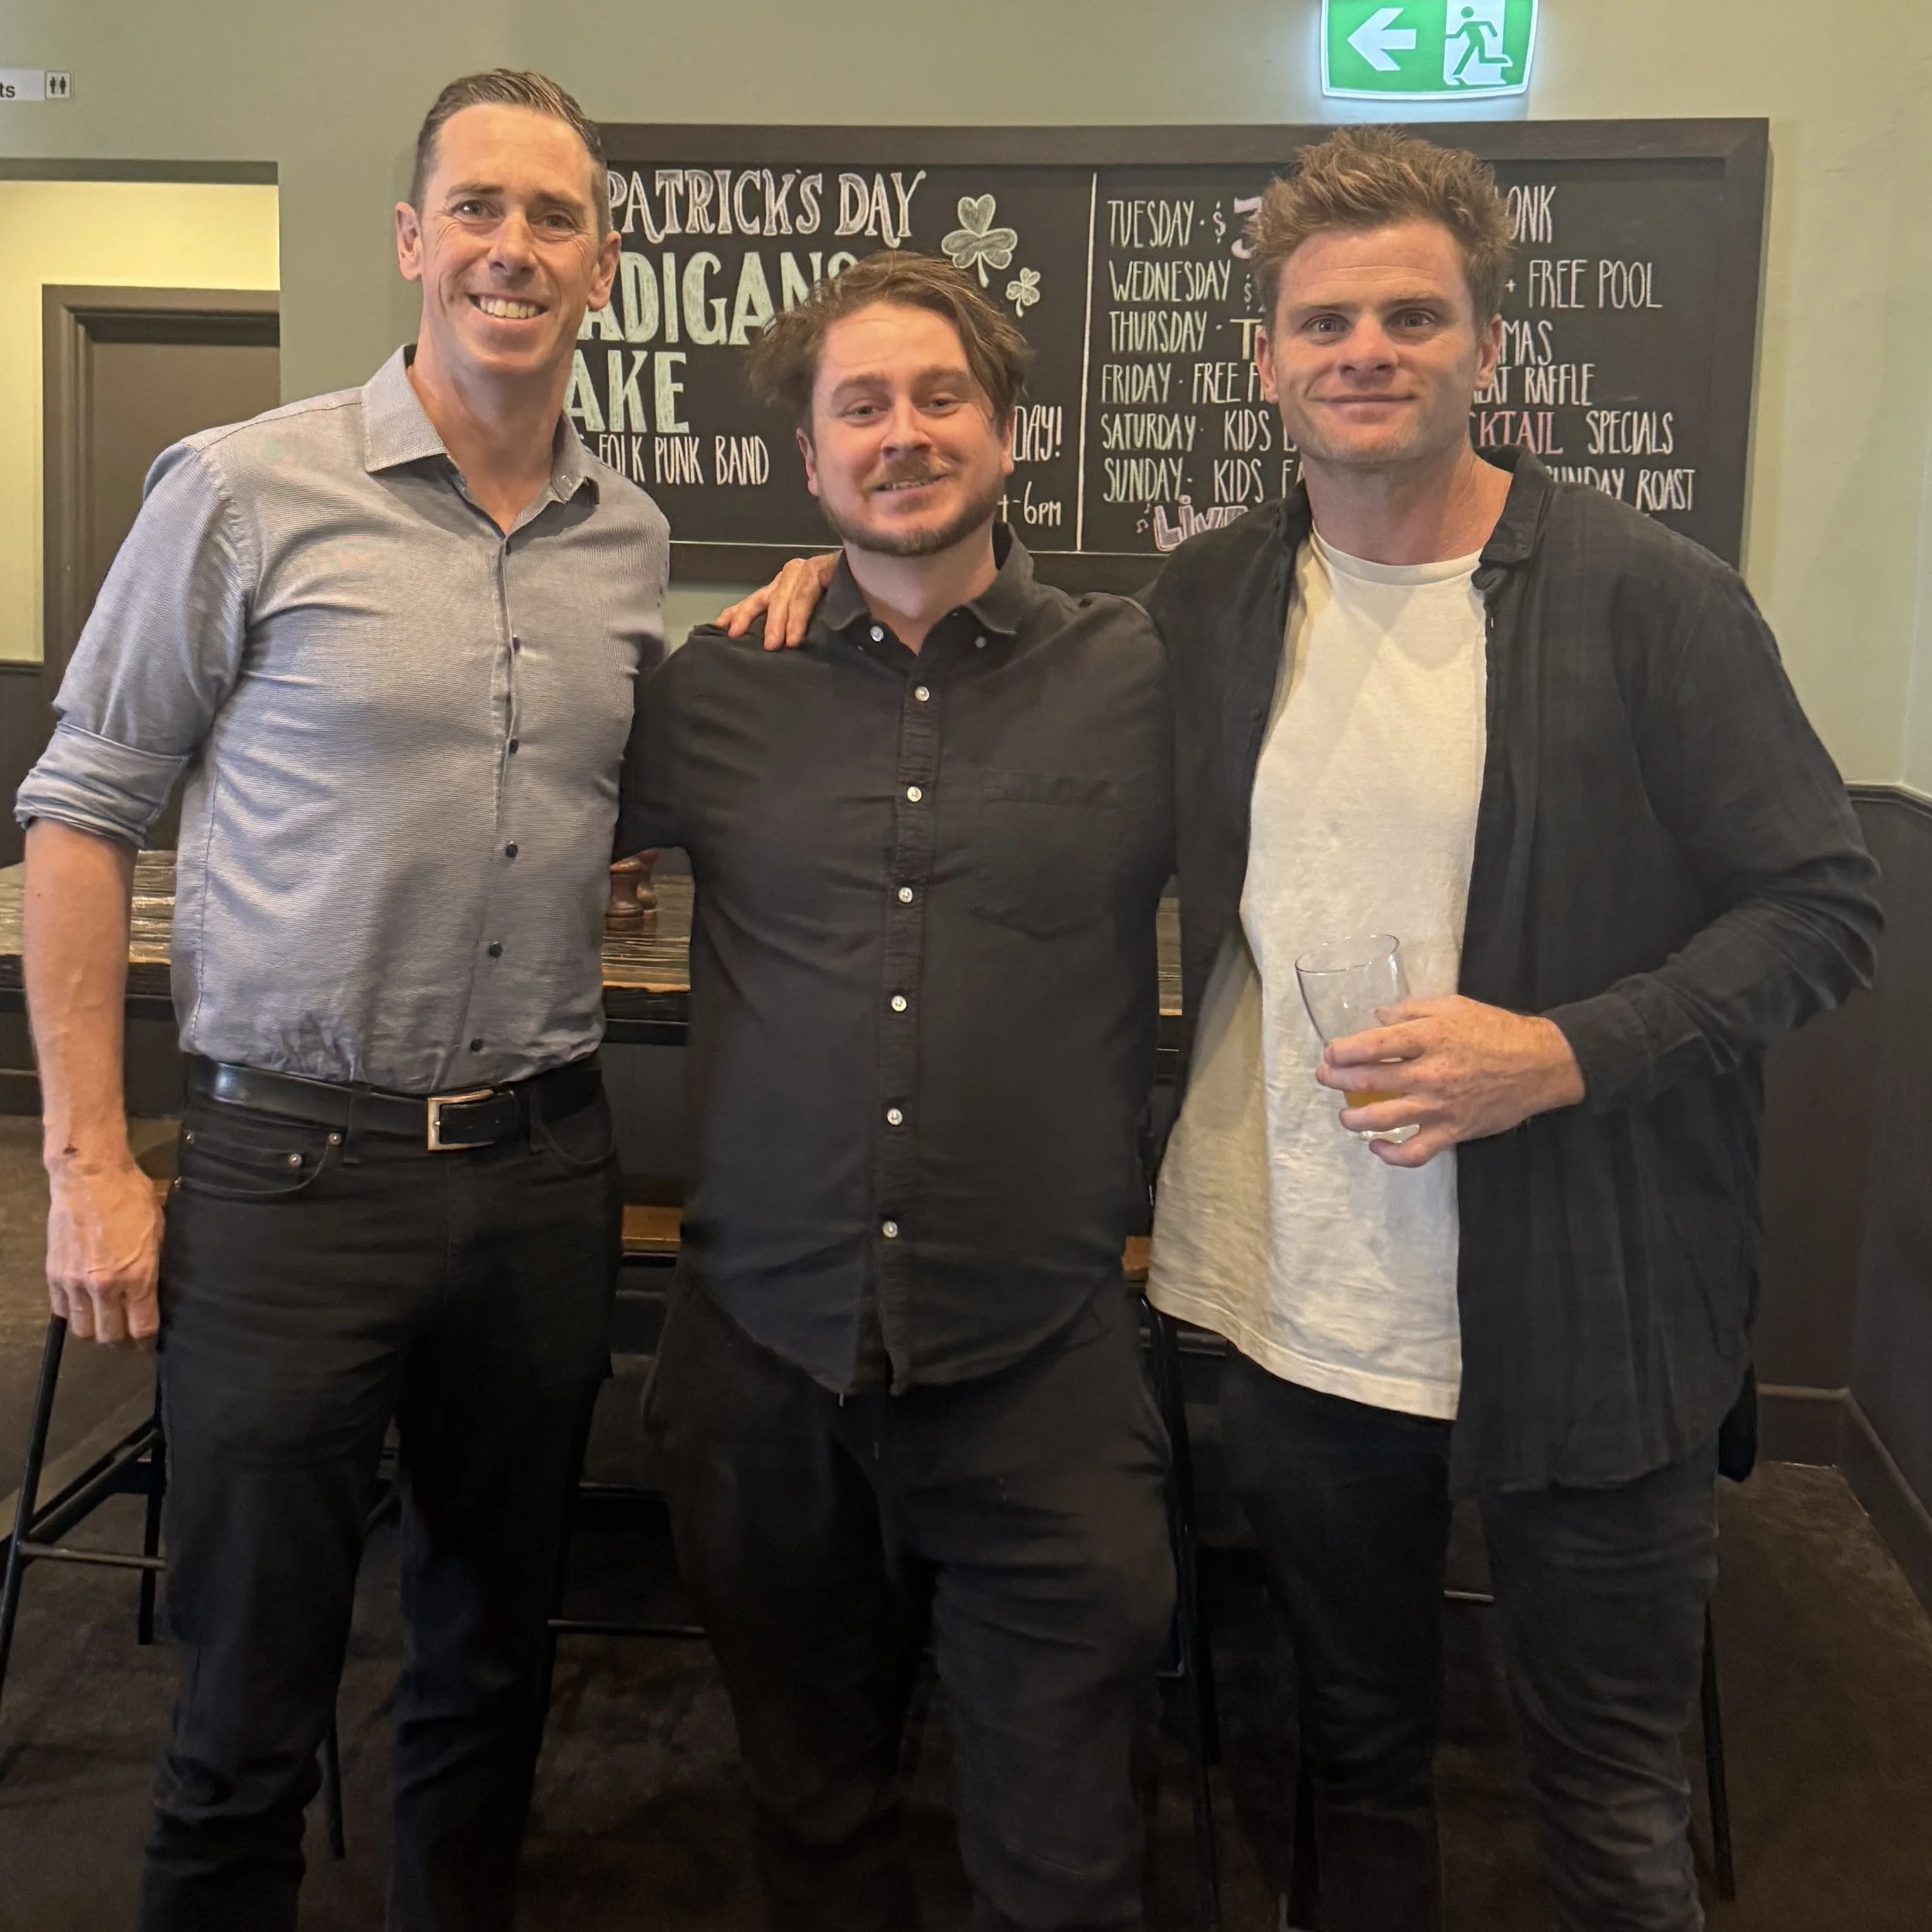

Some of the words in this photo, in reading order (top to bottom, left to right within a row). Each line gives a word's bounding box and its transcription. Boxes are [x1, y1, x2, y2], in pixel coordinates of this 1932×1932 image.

[835, 169, 927, 248] DAY
[1107, 199, 1195, 248] TUESDAY
[1108, 259, 1231, 301] WEDNESDAY
[1528, 260, 1589, 308] FREE
[1598, 260, 1663, 308] POOL
[1108, 311, 1208, 352] THURSDAY
[1102, 362, 1172, 404] FRIDAY
[1192, 362, 1241, 404] FREE
[1525, 363, 1596, 406] RAFFLE
[1100, 413, 1197, 452] SATURDAY
[1224, 410, 1271, 452] KIDS
[1468, 410, 1564, 454] KTAIL
[1585, 410, 1674, 455] SPECIALS
[655, 435, 704, 485] PUNK
[715, 435, 769, 485] BAND
[1103, 457, 1184, 502] SUNDAY
[1213, 457, 1264, 503] KIDS
[1635, 468, 1696, 512] ROAST
